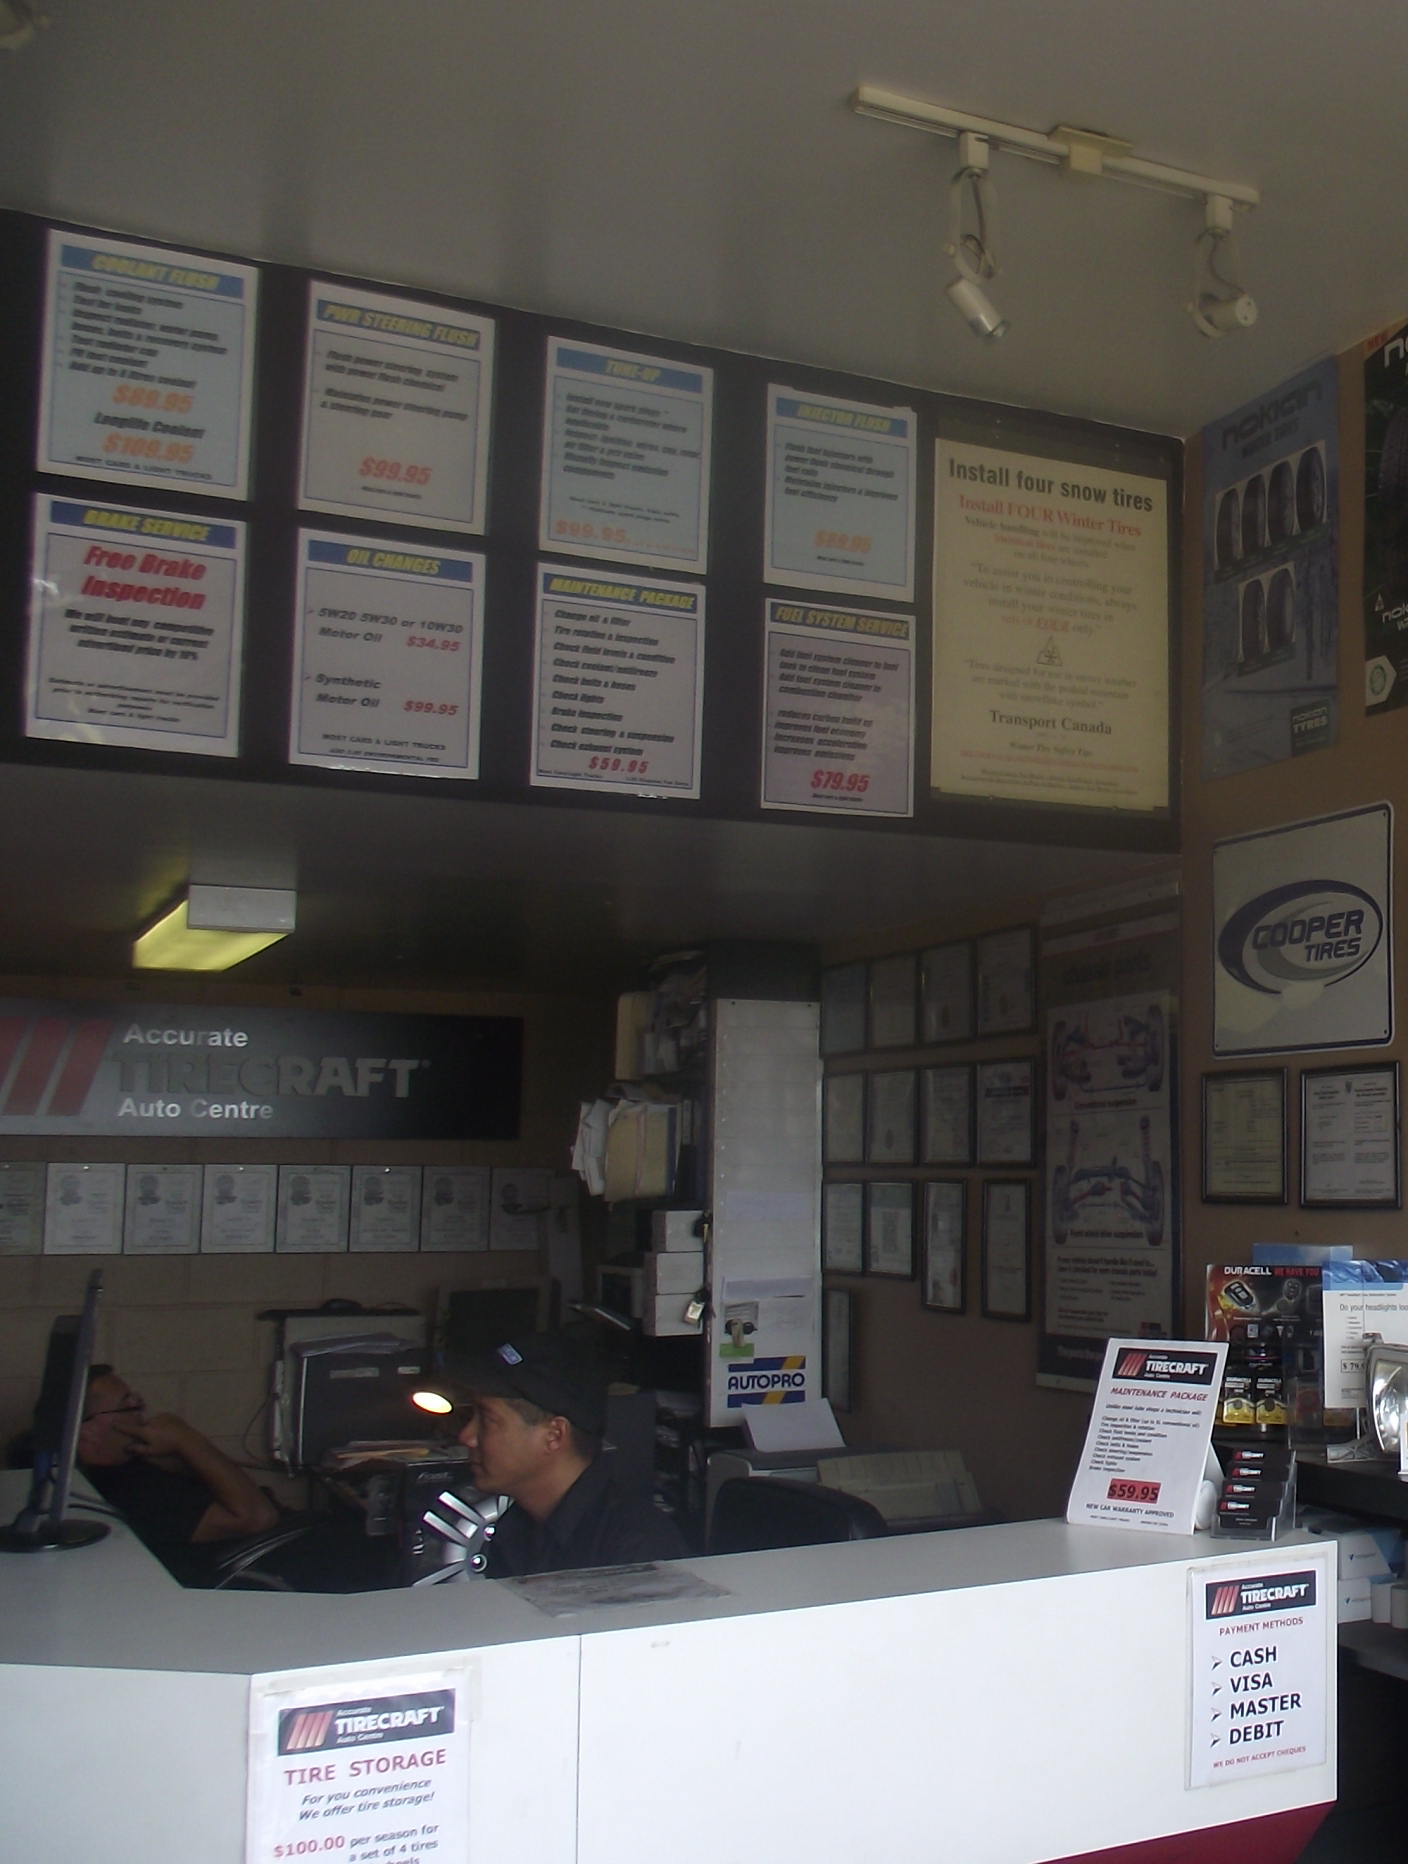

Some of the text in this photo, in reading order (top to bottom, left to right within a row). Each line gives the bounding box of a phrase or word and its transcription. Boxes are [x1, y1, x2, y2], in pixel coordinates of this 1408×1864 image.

[323, 303, 479, 347] PWR STEERING FLUSH
[949, 458, 1153, 512] Install four snow tires
[83, 509, 210, 541] BRAKE SERVICE
[959, 494, 1142, 537] Install FOUR Winter Tires
[84, 545, 208, 580] Free Brake
[346, 548, 441, 575] OIL CHANGES
[81, 575, 206, 610] Inspection
[550, 578, 695, 610] MAINTENANCE PACKAGE
[319, 607, 463, 634] 5W20 5W30 or 10W30
[776, 606, 910, 637] FUEL SYSTEM SERVICE
[319, 626, 383, 643] Motor Oil
[407, 636, 462, 652] $34.95
[316, 673, 382, 689] Synthetic
[316, 693, 380, 708] Motor Oil
[404, 700, 459, 716] $99.95
[989, 709, 1112, 736] Transport Canada
[810, 769, 870, 793] $79.95
[1251, 909, 1365, 951] COOPER
[1304, 938, 1361, 964] TIRES
[124, 1024, 249, 1048] Accurate
[112, 1054, 421, 1098] TIRECRAFT
[119, 1098, 274, 1120] Auto Centre
[1224, 1266, 1319, 1276] DURACELL WE HAVE YOU
[1340, 1303, 1348, 1311] Do
[1350, 1304, 1364, 1312] your
[1365, 1303, 1398, 1312] headlights
[1145, 1360, 1208, 1376] TIRECRAFT
[727, 1372, 806, 1391] AUTOPRO
[1110, 1387, 1209, 1401] MAINTENANCE PACKAGE
[1108, 1483, 1160, 1501] $59.95
[1112, 1505, 1143, 1515] WARRANTY
[1144, 1508, 1174, 1518] APPROVED
[1240, 1583, 1309, 1605] TIRECRAFT
[1219, 1616, 1304, 1637] PAYMENT METHODS
[1230, 1645, 1277, 1668] CASH
[1230, 1672, 1273, 1694] VISA
[1230, 1693, 1302, 1720] MASTER
[334, 1706, 445, 1735] TIRECRAFT
[1229, 1720, 1284, 1745] DEBIT
[1236, 1756, 1250, 1764] NOT
[1251, 1750, 1275, 1761] ACCEPT
[1276, 1745, 1306, 1757] CHEQUES
[283, 1749, 447, 1786] TIRE STORAGE
[301, 1778, 432, 1806] For you convenience
[299, 1791, 436, 1821] We offer tire storage!
[273, 1823, 440, 1858] $100.00 per season for
[349, 1853, 357, 1862] a
[360, 1848, 380, 1860] set
[383, 1844, 397, 1857] of
[399, 1843, 407, 1854] 4
[411, 1838, 439, 1852] tires
